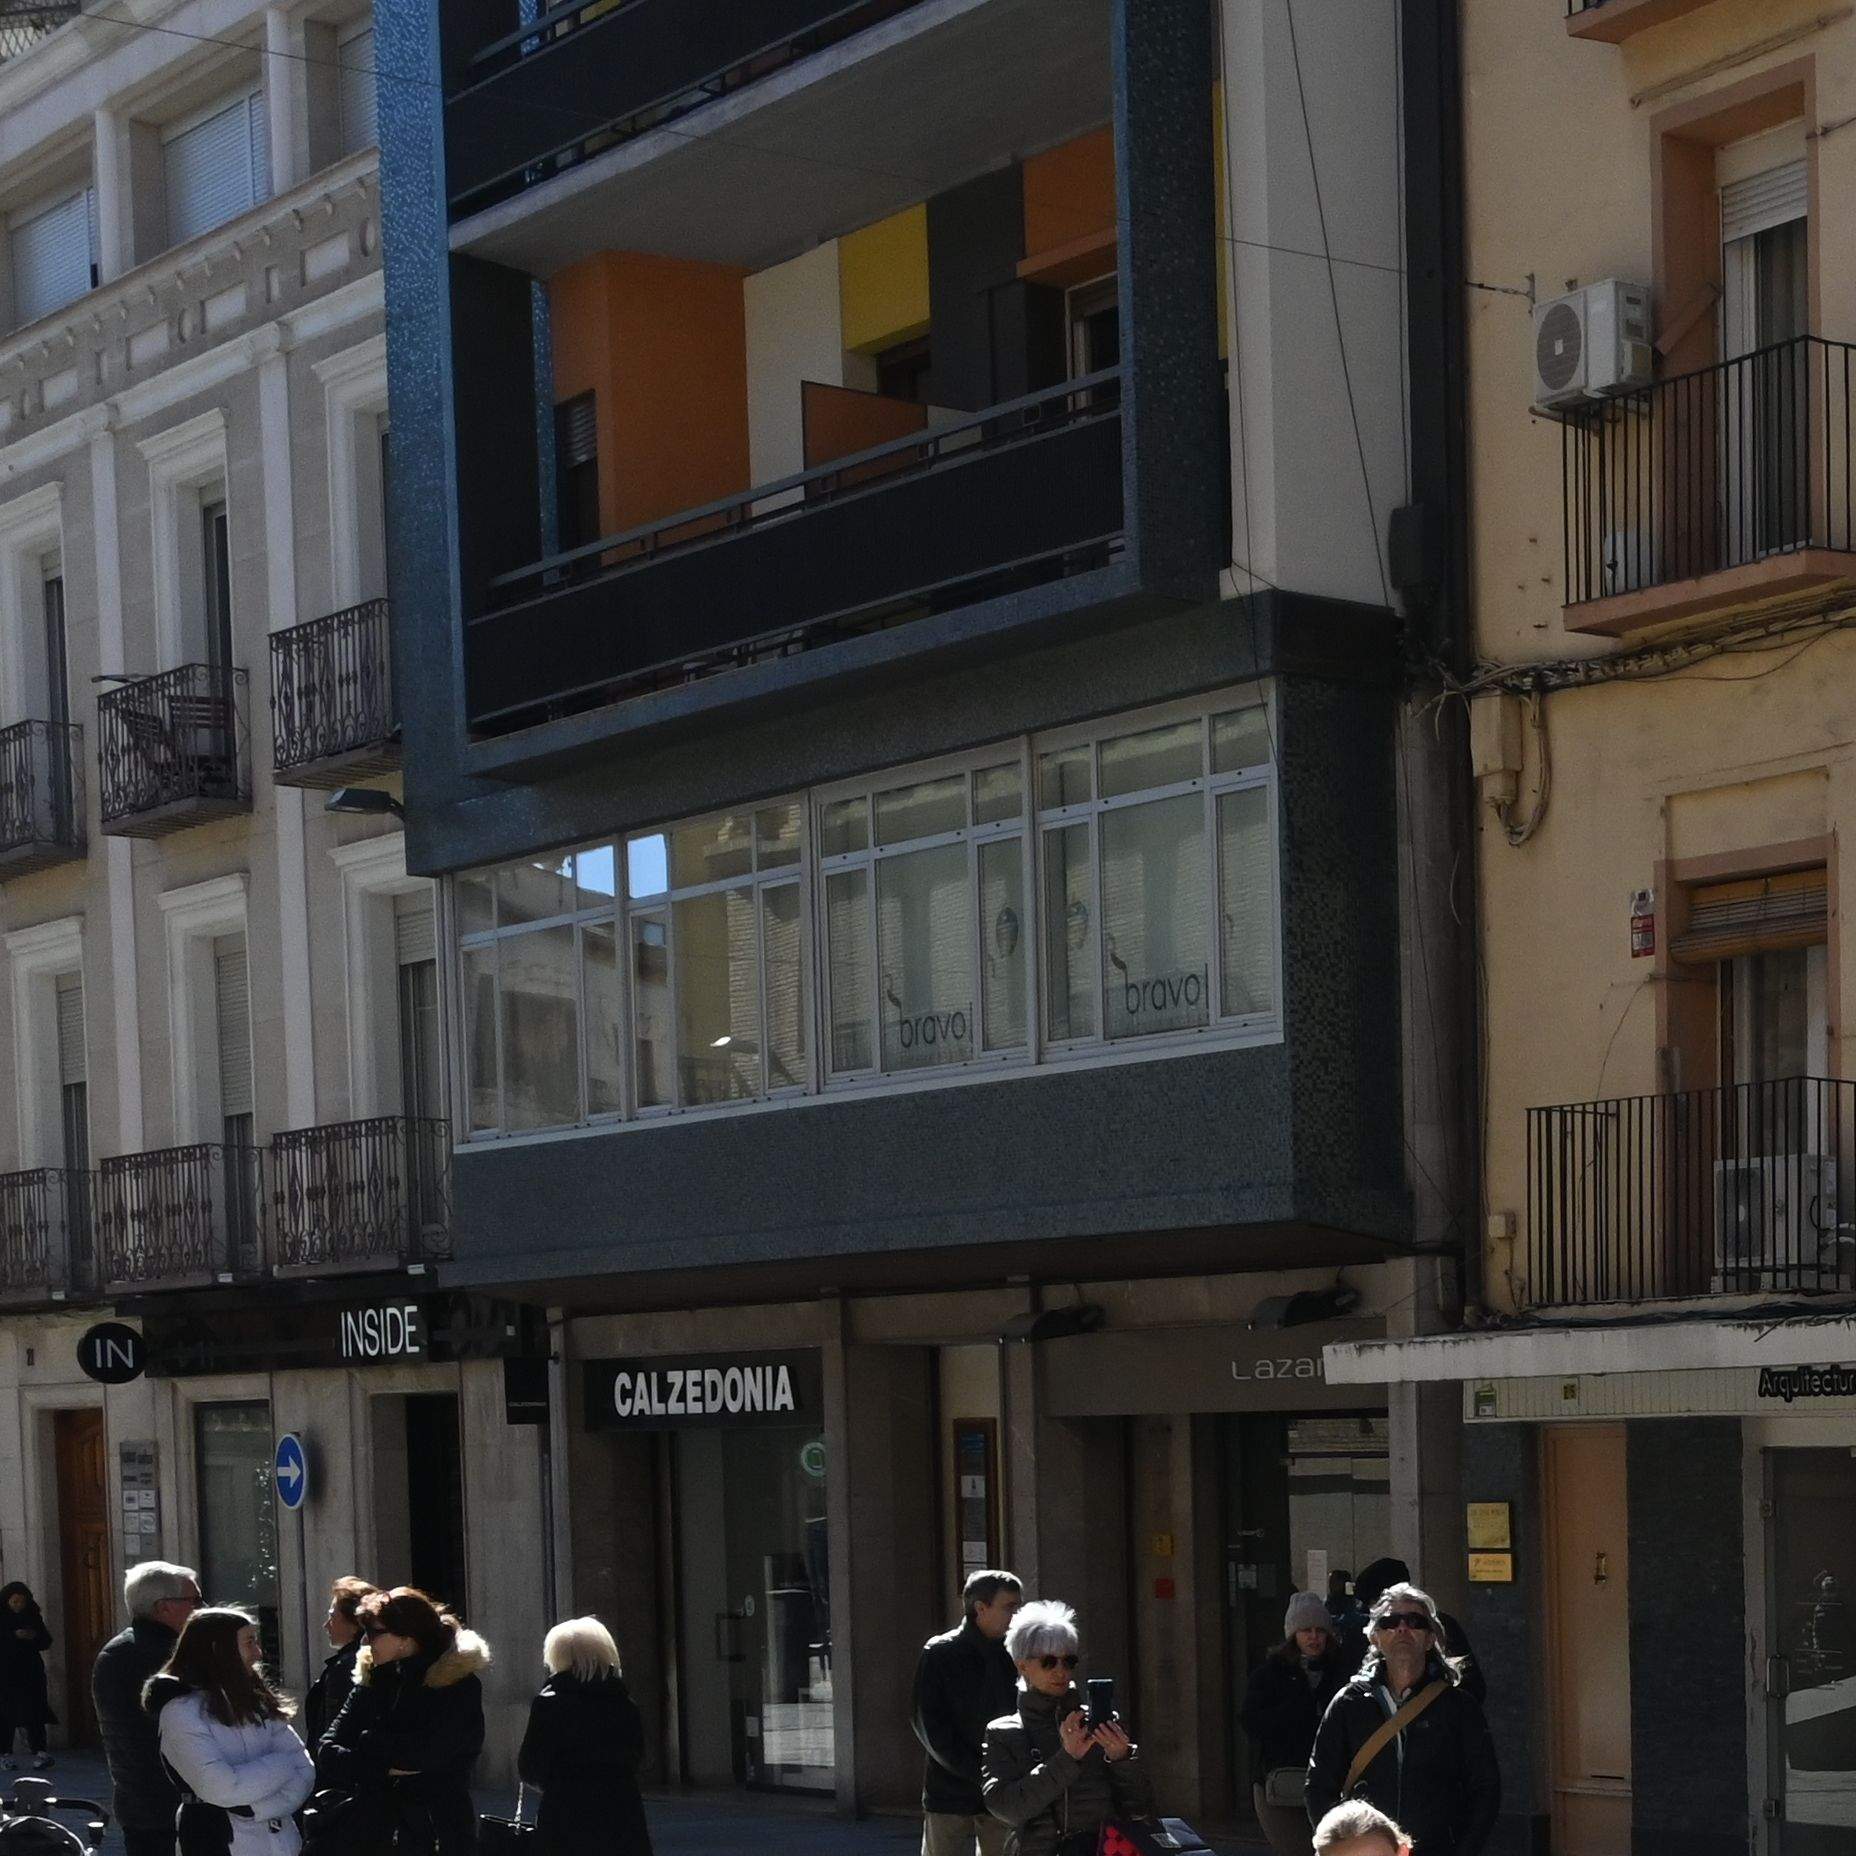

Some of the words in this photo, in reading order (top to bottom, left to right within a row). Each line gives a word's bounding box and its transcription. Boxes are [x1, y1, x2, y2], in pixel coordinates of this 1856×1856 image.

[94, 1338, 135, 1369] IN
[340, 1305, 420, 1358] INSIDE
[613, 1365, 795, 1418] CALZEDONIA
